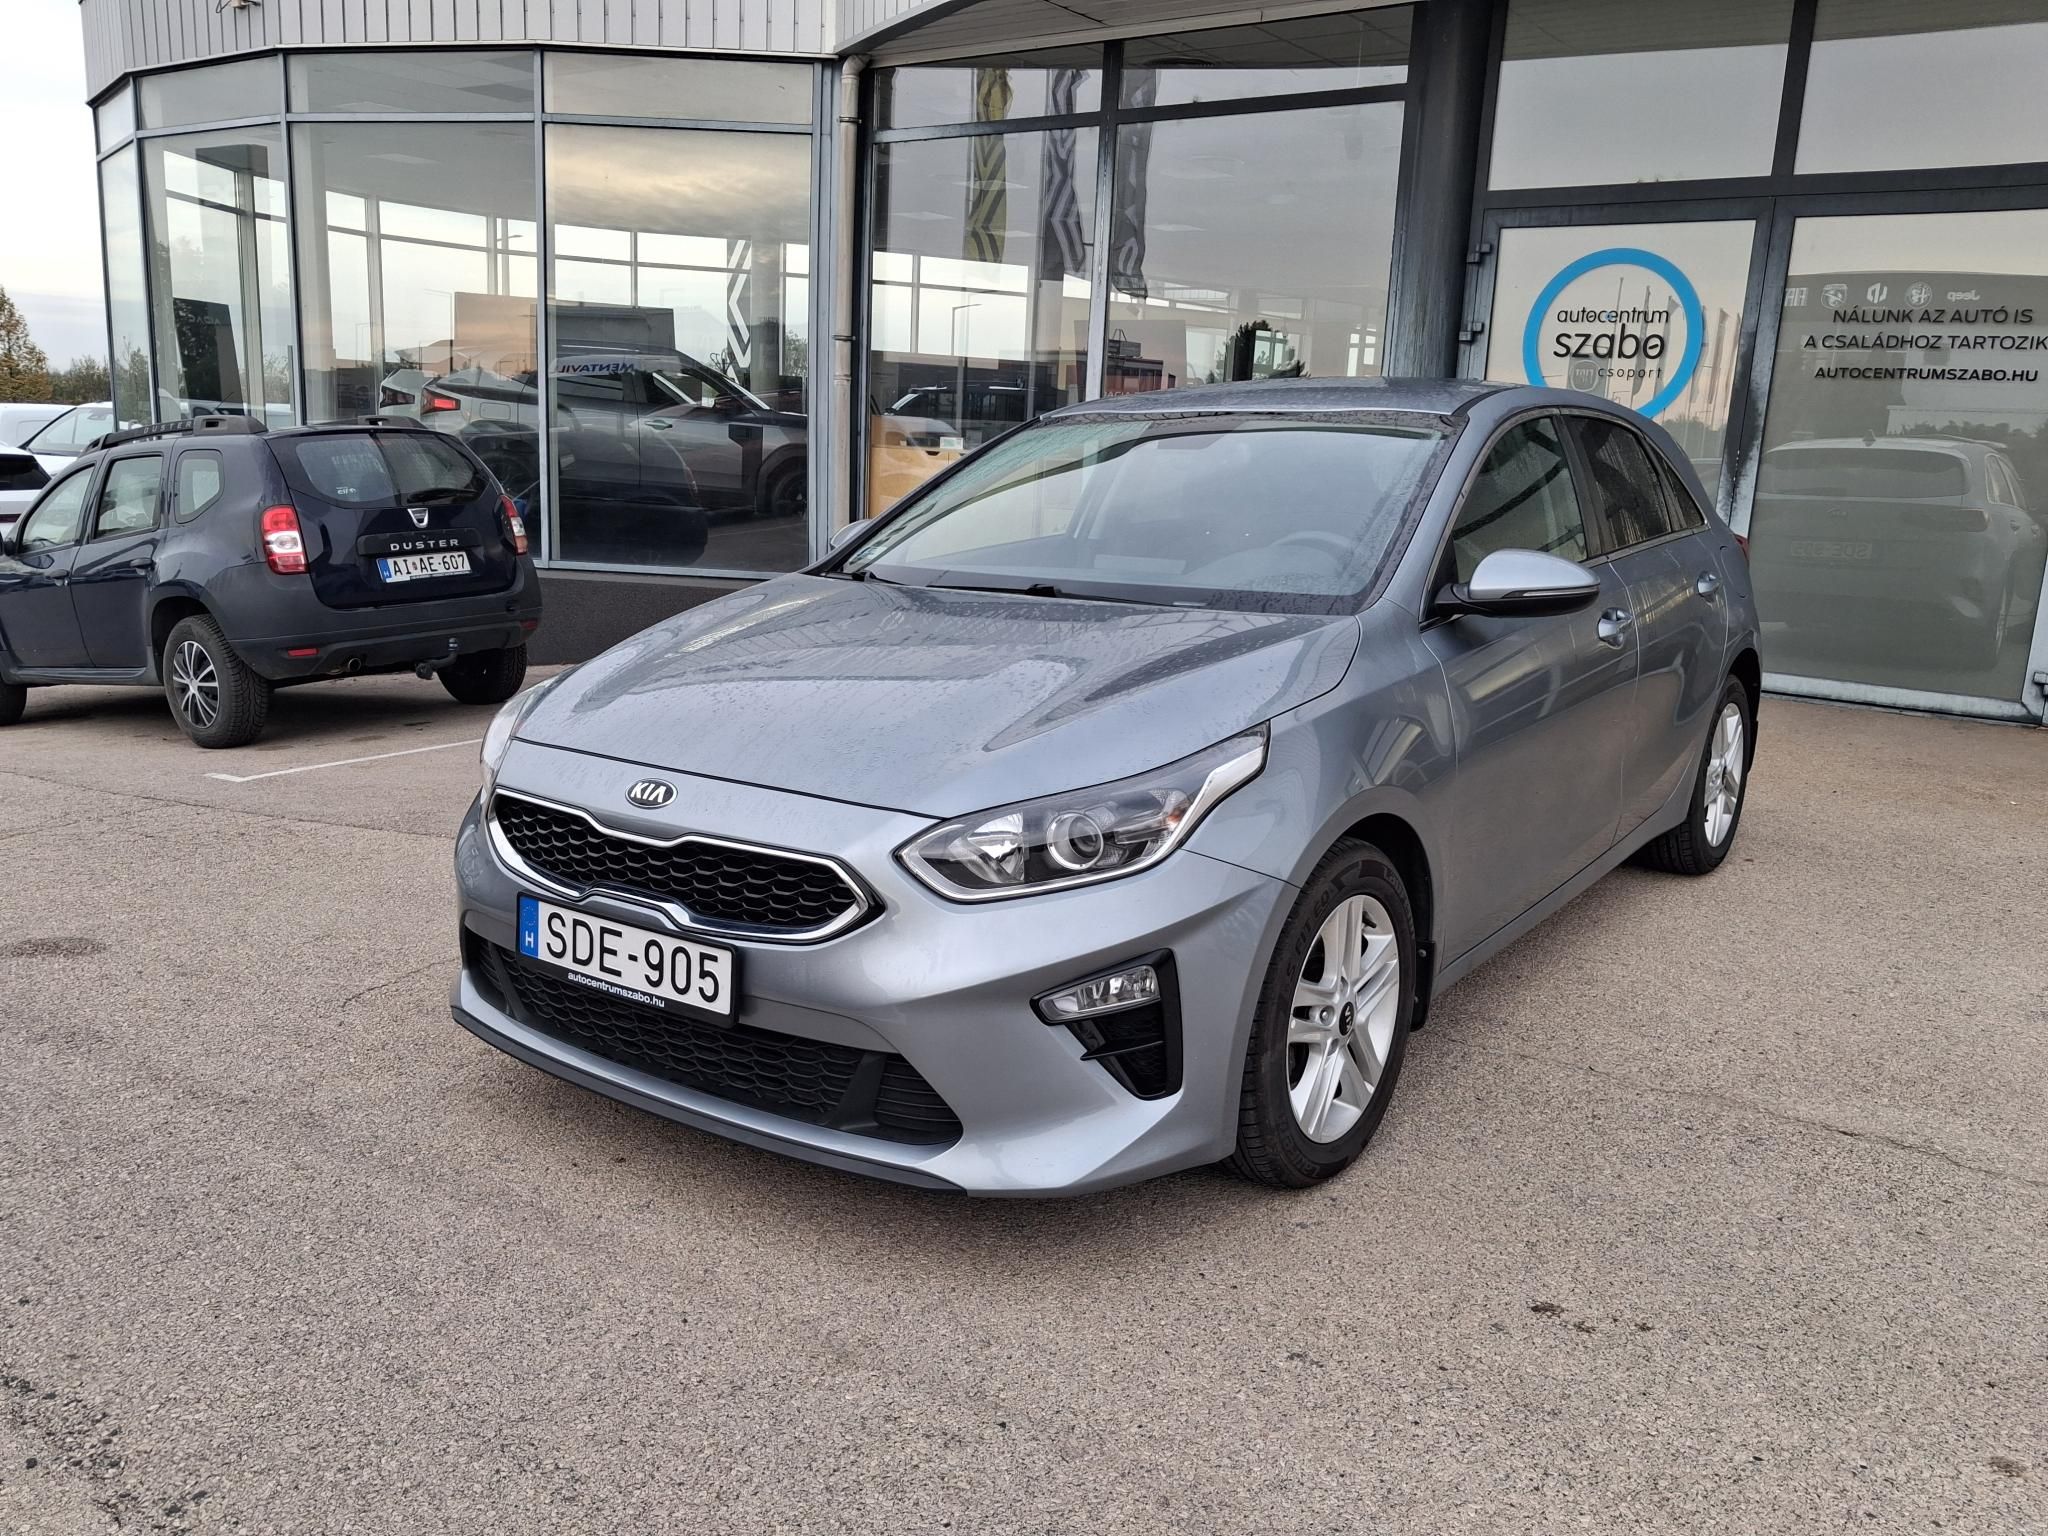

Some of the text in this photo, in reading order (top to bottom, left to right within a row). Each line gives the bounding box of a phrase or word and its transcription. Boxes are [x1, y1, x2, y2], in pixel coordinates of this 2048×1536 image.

[1557, 307, 1669, 323] autocentrum
[1832, 305, 2034, 324] NÁLUNK AZ AUTÓ IS
[1803, 332, 2048, 350] A CSALÁDHOZ TARTOZIK
[1598, 368, 1662, 381] csoport
[1814, 367, 2039, 382] AUTOCENTRUMSZABO.HU
[143, 421, 192, 434] DUSTER
[389, 538, 460, 551] DUSTER
[393, 559, 411, 576] AI
[630, 782, 667, 803] KIA
[525, 931, 534, 949] H
[546, 911, 719, 1003] SDE-905
[568, 971, 665, 1008] autocentrumszabo.hu
